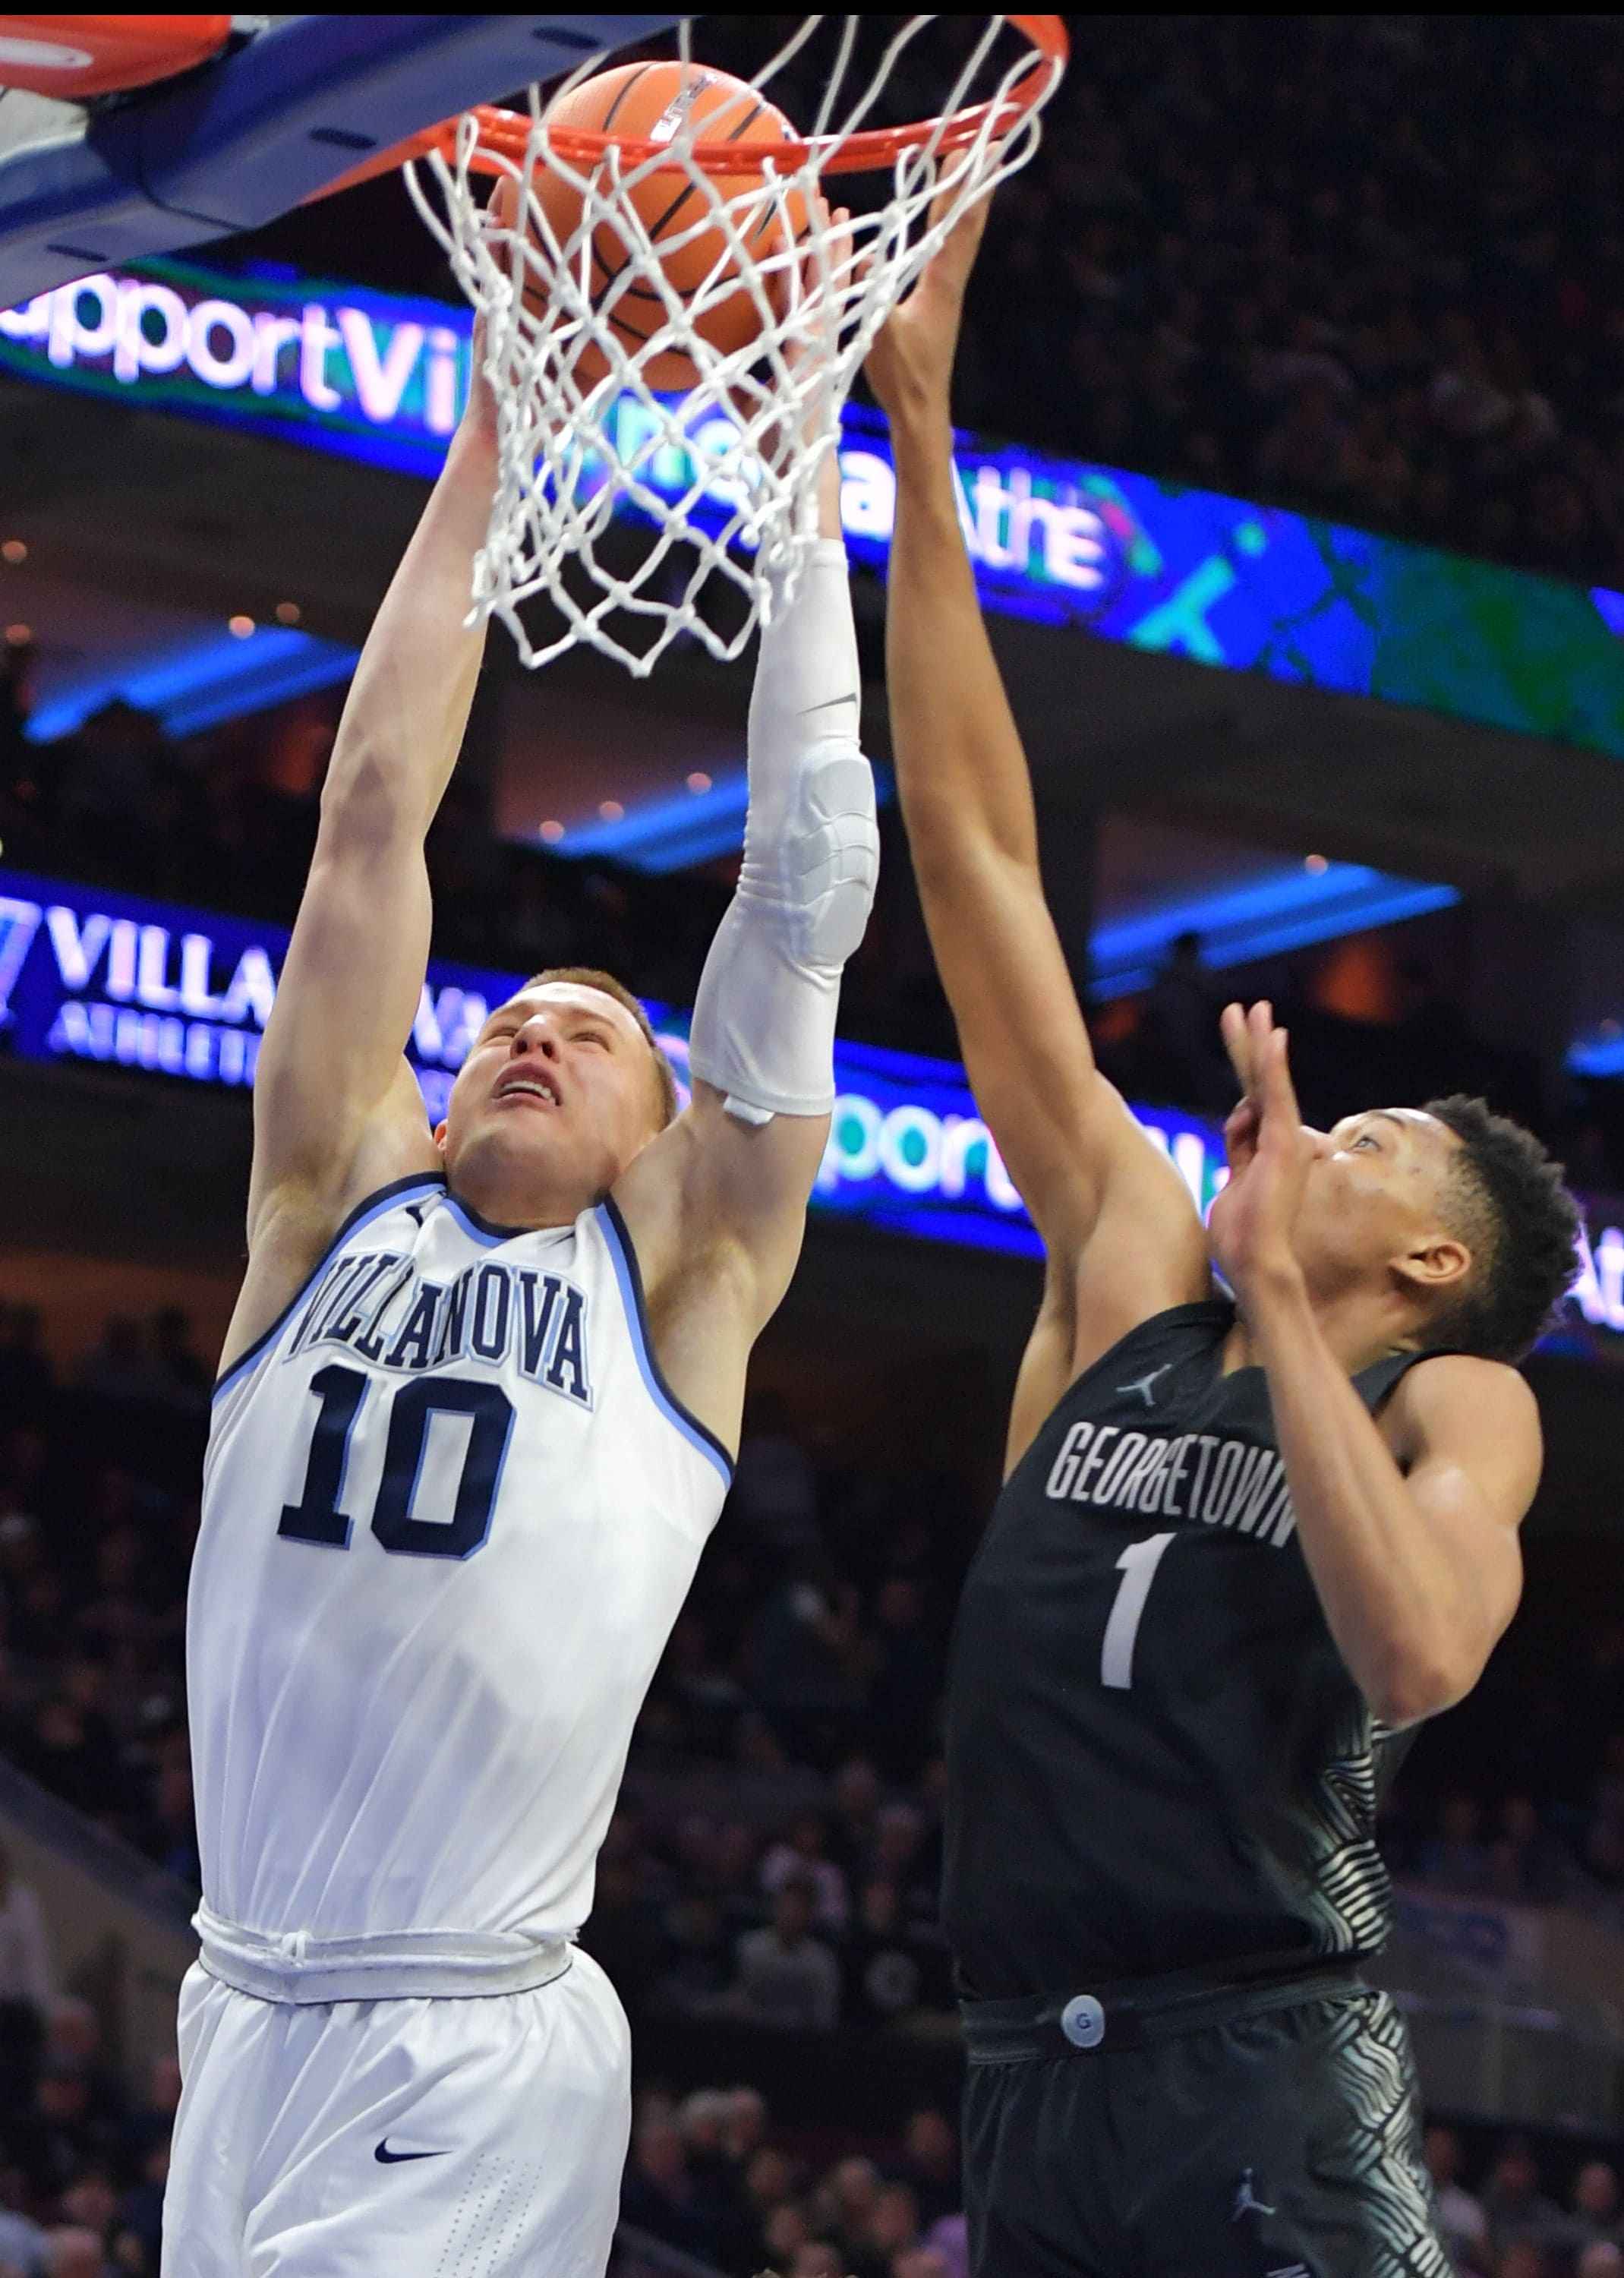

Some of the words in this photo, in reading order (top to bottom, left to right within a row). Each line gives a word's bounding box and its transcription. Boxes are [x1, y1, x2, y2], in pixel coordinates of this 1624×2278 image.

[283, 1249, 594, 1412] VILLANOVA
[276, 1364, 518, 1561] 10
[1101, 1532, 1177, 1690] 1
